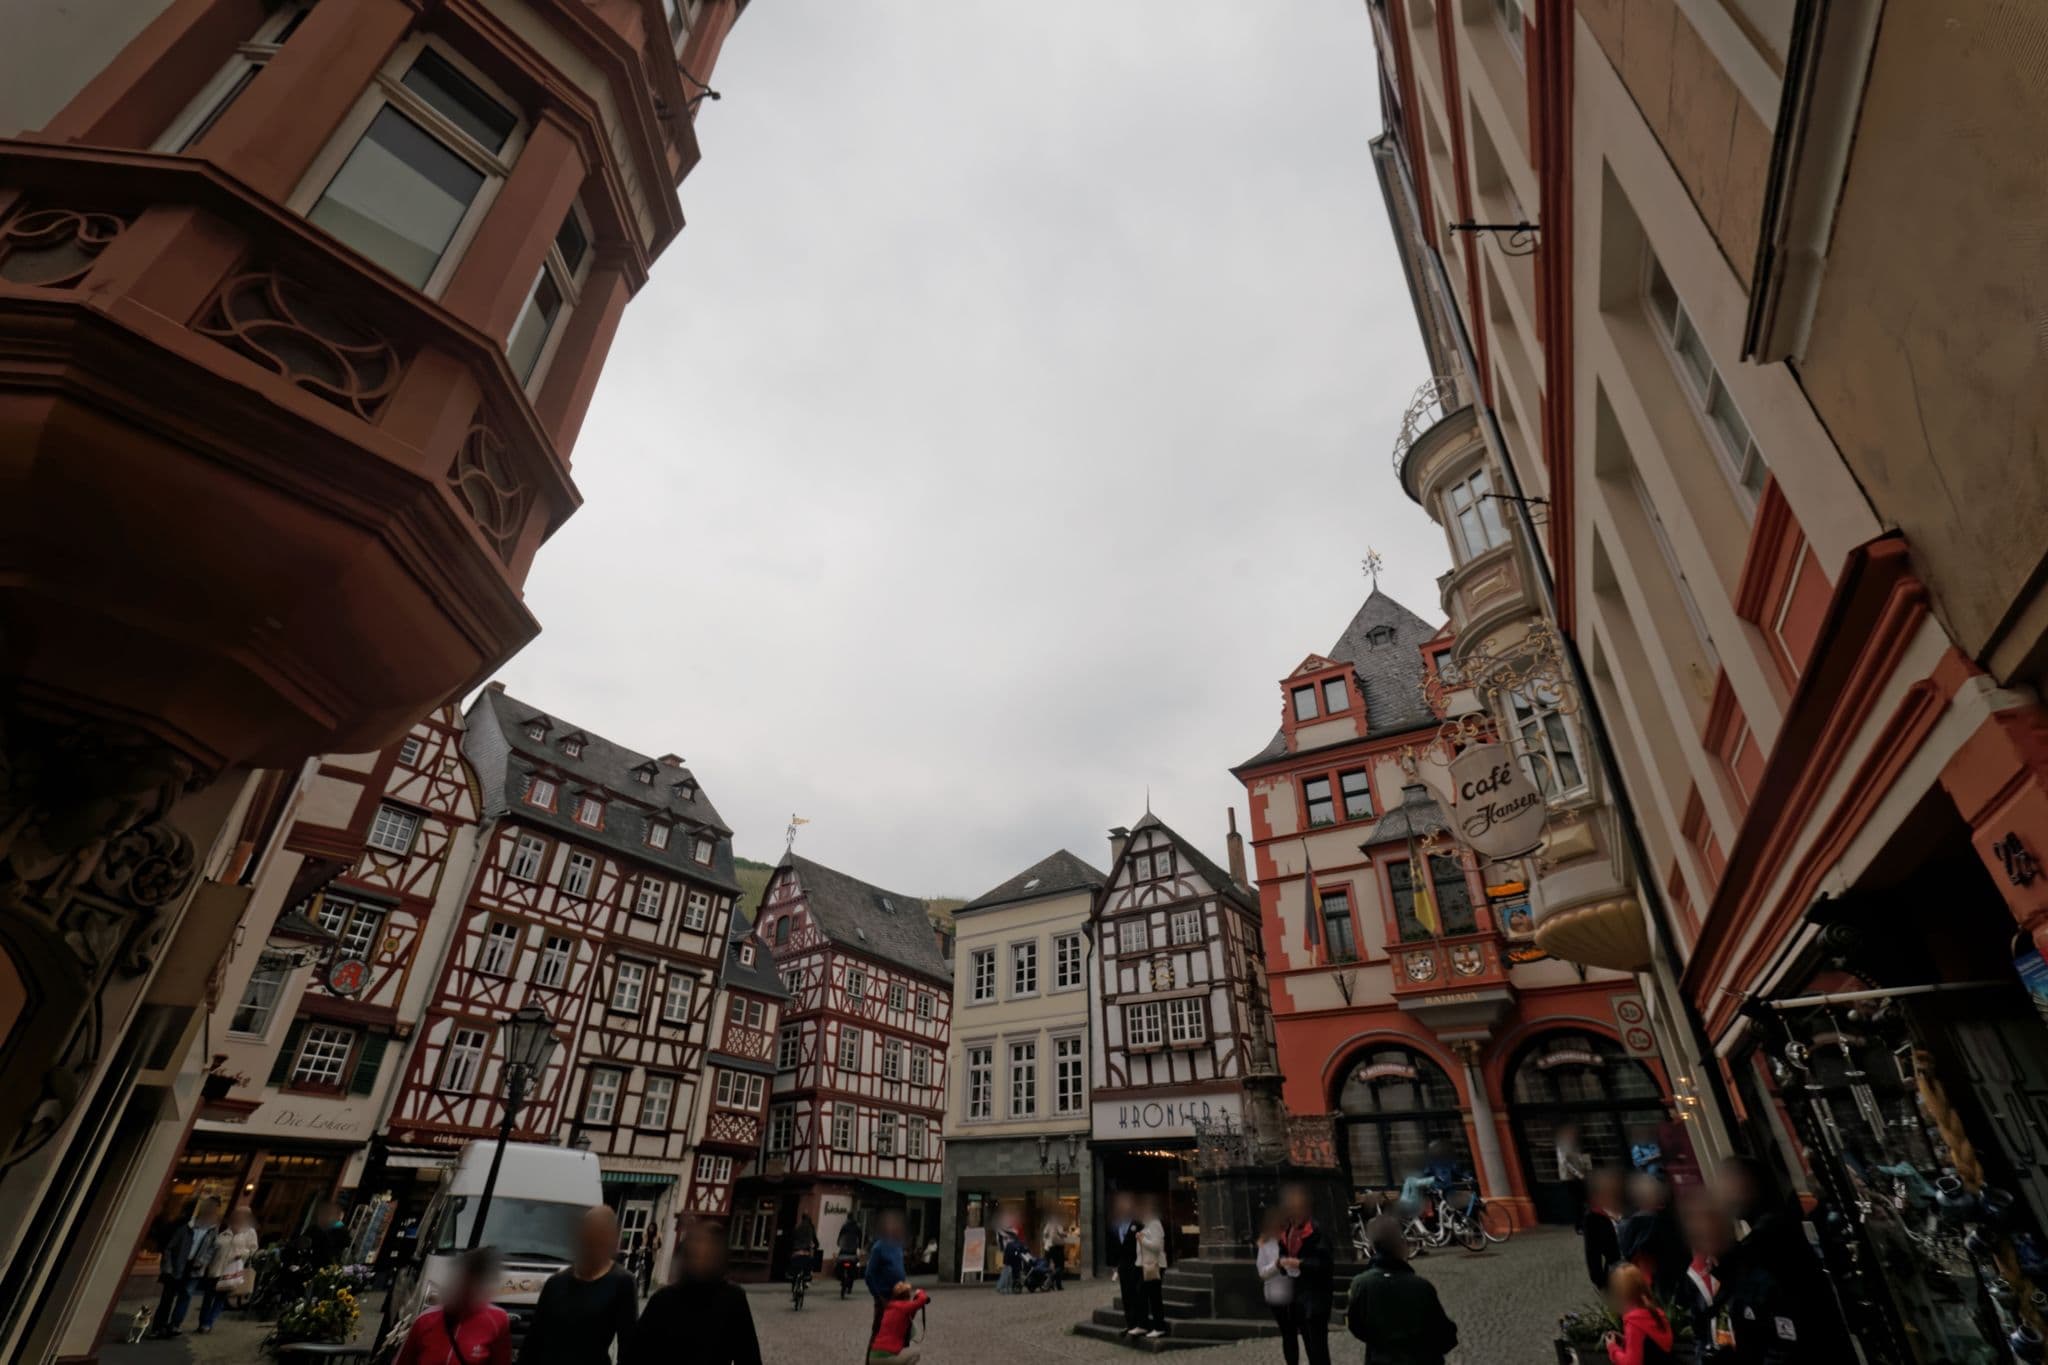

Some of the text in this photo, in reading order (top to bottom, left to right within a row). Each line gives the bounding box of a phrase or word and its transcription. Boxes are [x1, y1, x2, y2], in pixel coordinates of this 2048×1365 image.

[1461, 761, 1512, 801] café
[1463, 792, 1538, 838] Hansen
[273, 1110, 305, 1128] Die
